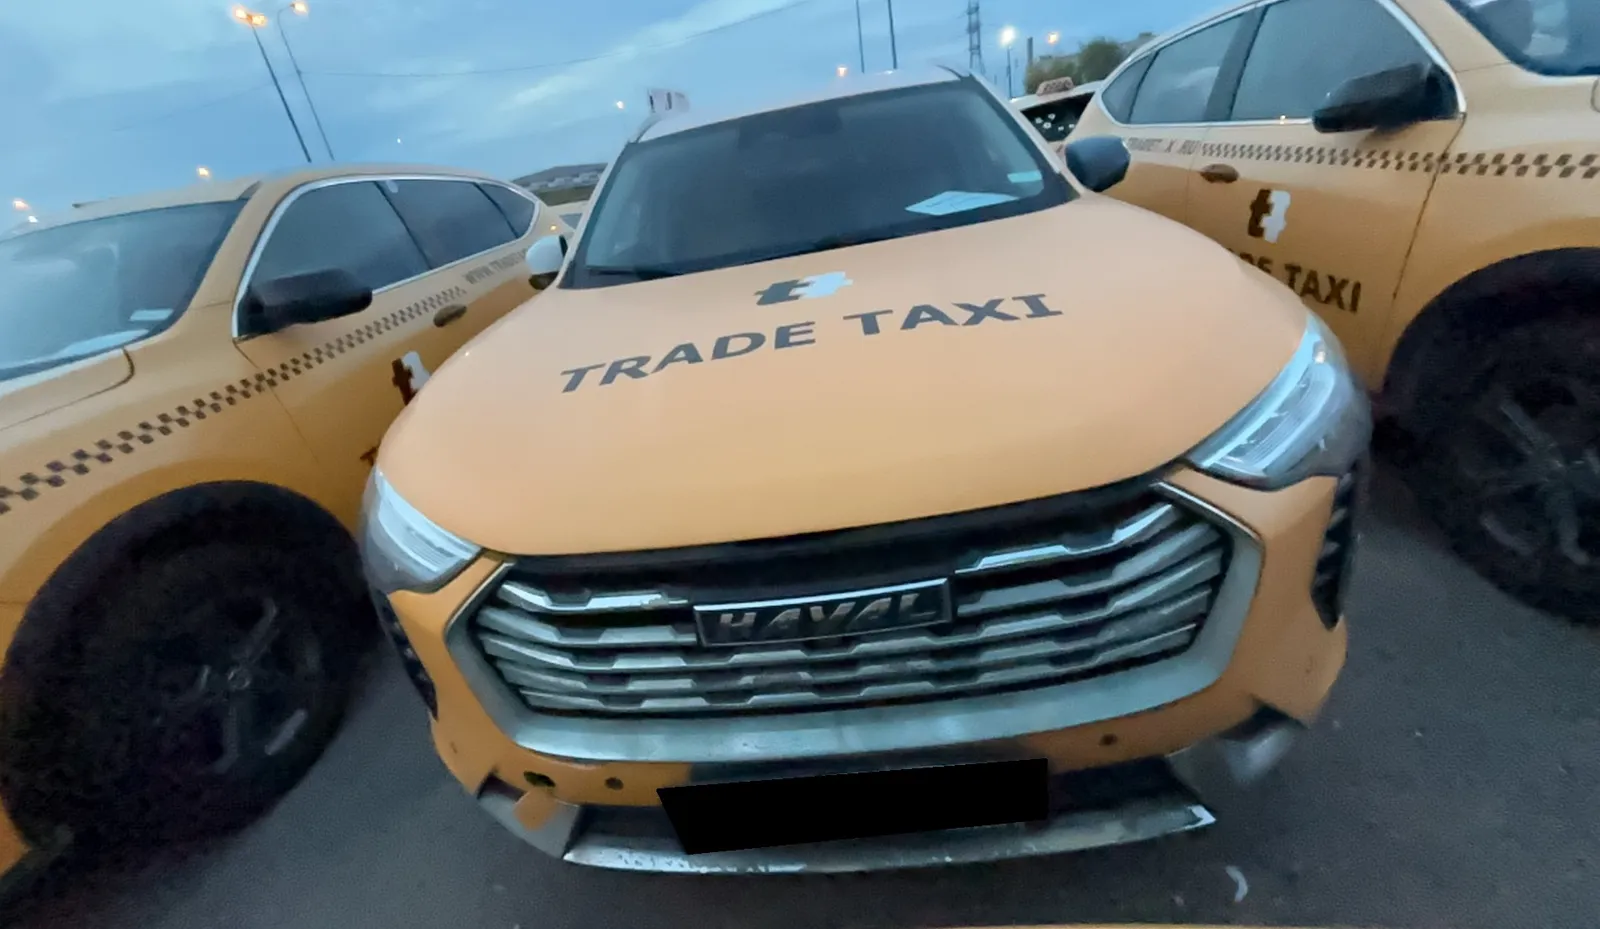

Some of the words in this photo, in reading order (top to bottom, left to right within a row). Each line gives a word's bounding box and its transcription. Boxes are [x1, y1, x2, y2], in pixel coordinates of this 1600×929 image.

[1284, 262, 1362, 314] TAXI
[560, 321, 816, 393] TRADE
[843, 293, 1063, 336] TAXI
[718, 592, 937, 640] HAVAL
